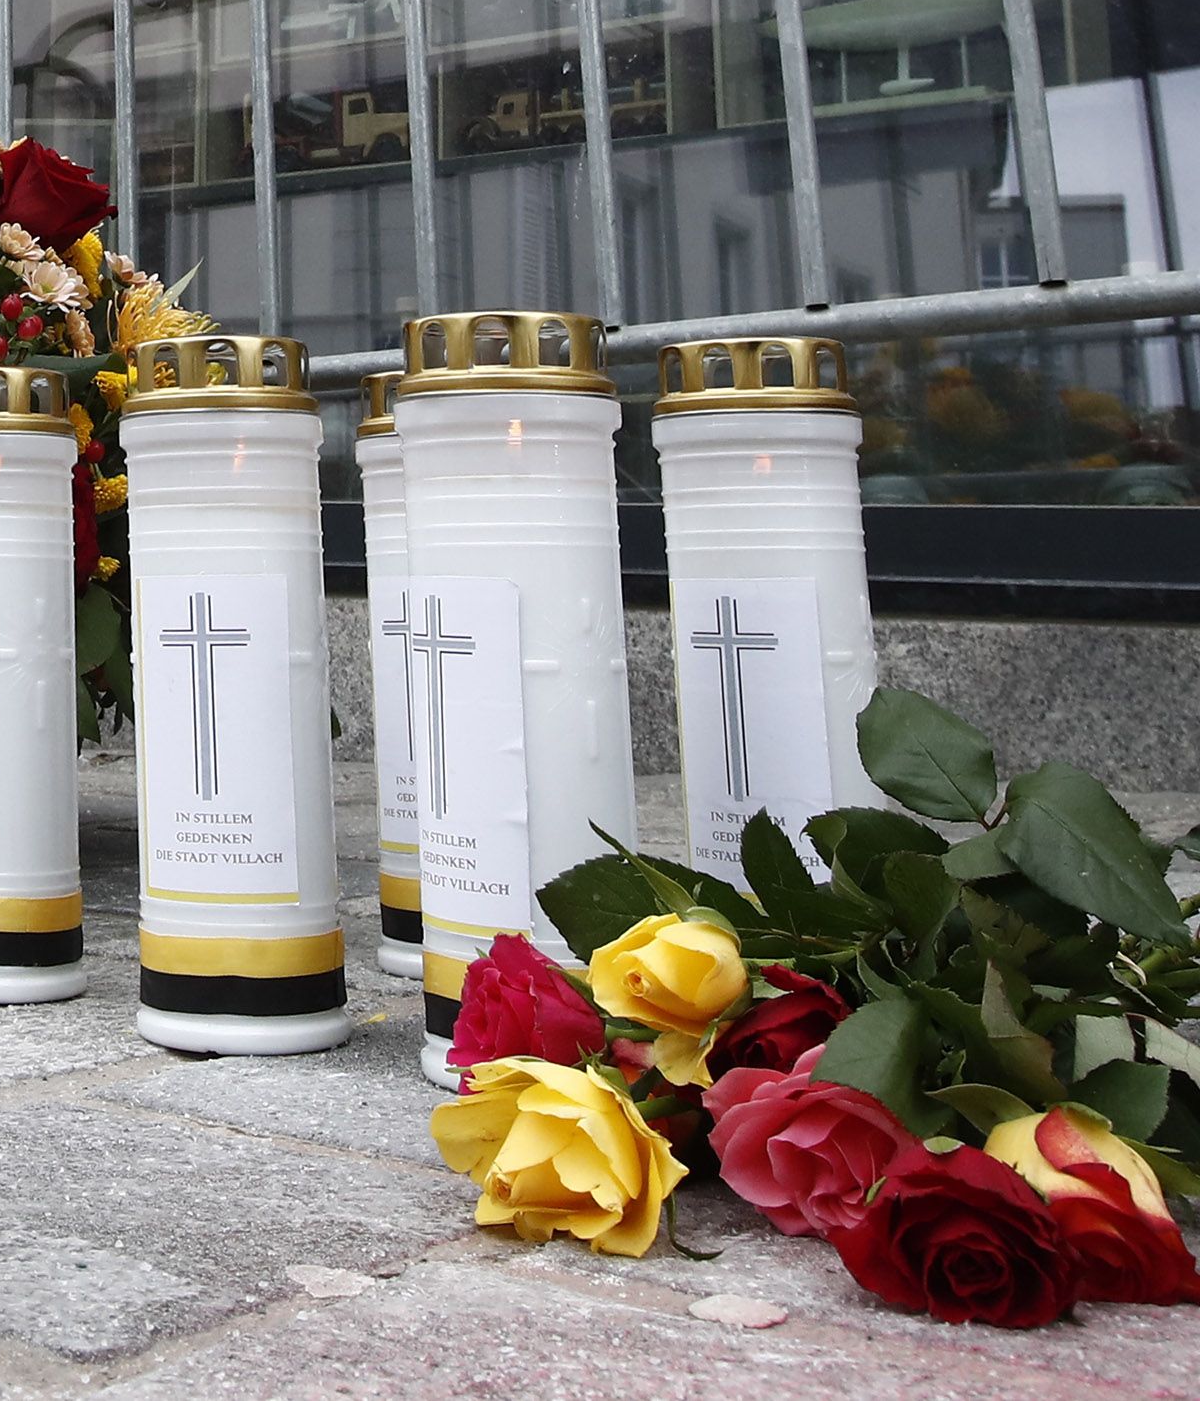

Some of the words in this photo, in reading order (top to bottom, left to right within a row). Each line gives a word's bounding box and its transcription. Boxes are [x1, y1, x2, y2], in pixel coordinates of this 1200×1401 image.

[175, 812, 191, 823] IN
[193, 812, 254, 825] STILLEM
[711, 811, 725, 822] IN
[176, 831, 253, 845] GEDENKEN
[430, 831, 478, 850] STILLEM
[156, 849, 173, 861] DIE
[175, 851, 218, 864] STADT
[221, 853, 283, 865] VILLACH
[422, 850, 477, 870] GEDENKEN
[696, 847, 711, 859] DIE
[712, 850, 741, 863] STAD
[449, 877, 511, 896] VILLACH
